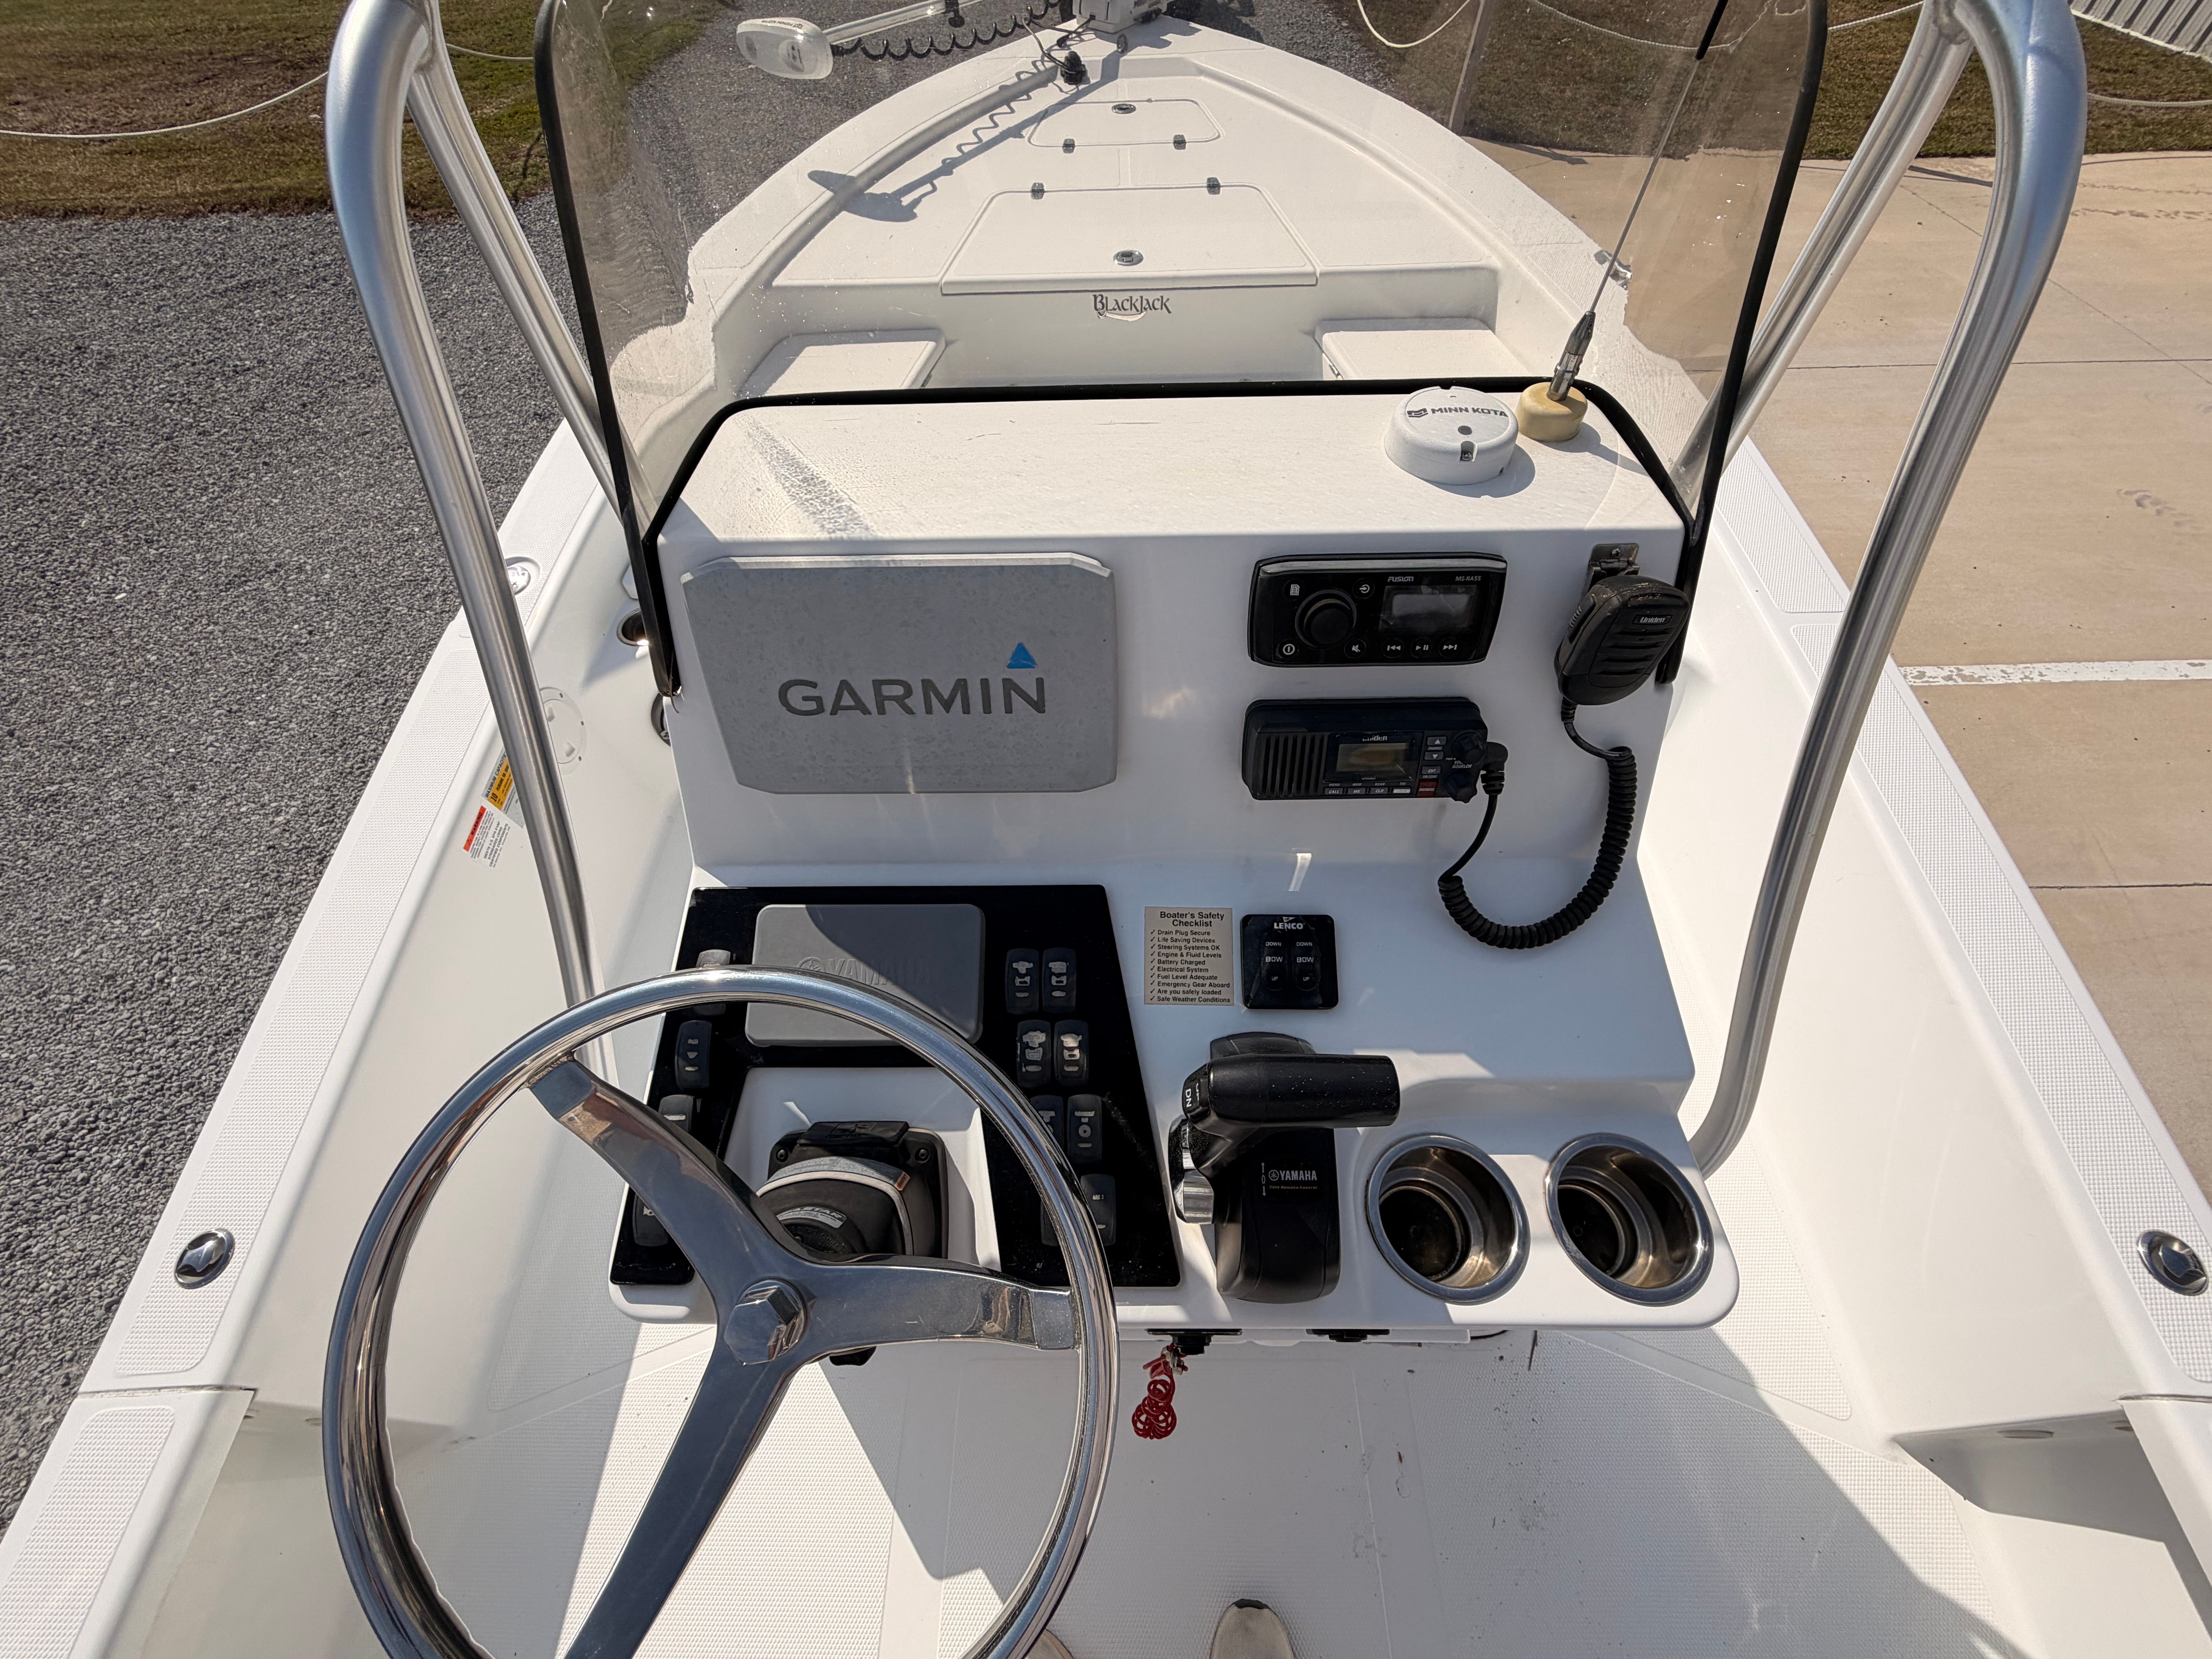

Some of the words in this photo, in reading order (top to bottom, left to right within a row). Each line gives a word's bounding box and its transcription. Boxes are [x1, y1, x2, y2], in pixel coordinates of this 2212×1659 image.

[1471, 407, 1509, 417] KOTA
[778, 678, 1045, 716] GARMIN
[484, 776, 496, 798] MAXIMUM
[495, 751, 507, 776] CAPACITIE
[490, 793, 498, 802] 10
[471, 812, 483, 835] WARNING
[1198, 912, 1224, 921] Safety
[1185, 1089, 1192, 1107] DN
[1279, 1170, 1317, 1181] YAMAHA
